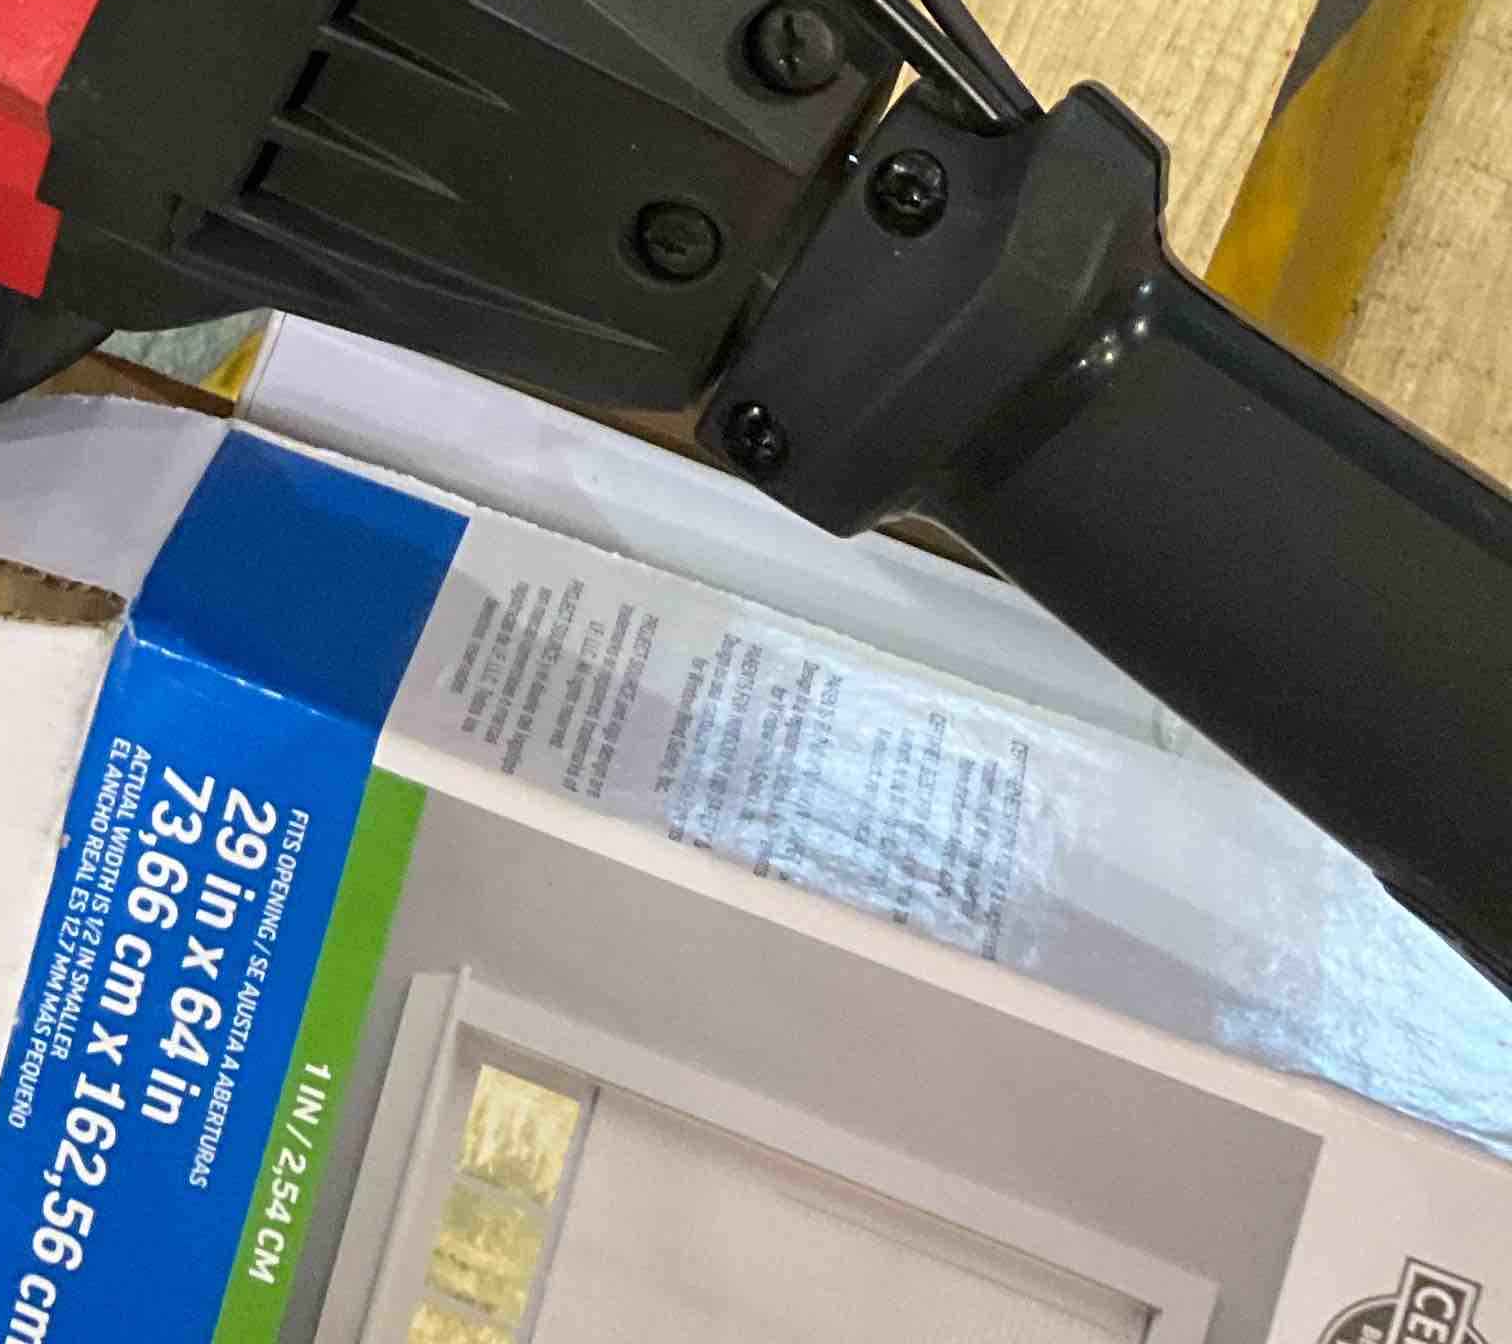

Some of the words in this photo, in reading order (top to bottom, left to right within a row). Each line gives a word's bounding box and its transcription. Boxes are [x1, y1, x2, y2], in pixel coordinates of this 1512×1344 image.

[111, 737, 131, 757] EL
[90, 753, 127, 834] ANCHO
[115, 744, 152, 819] ACTUAL
[127, 766, 216, 930] 73,66
[215, 787, 277, 870] 29
[282, 809, 310, 853] FITS
[75, 834, 105, 881] REAL
[97, 826, 131, 893] WIDTH
[68, 886, 90, 913] ES
[91, 893, 112, 914] IS
[195, 873, 256, 929] in
[257, 853, 297, 942] OPENING
[58, 915, 82, 954] 12.7
[81, 916, 105, 946] 1/2
[252, 939, 272, 957] /
[46, 953, 72, 992] MM
[75, 946, 97, 970] IN
[99, 933, 152, 1016] cm
[181, 935, 225, 980] x
[246, 954, 269, 983] SE
[33, 991, 61, 1037] MÁS
[49, 969, 90, 1060] SMALLER
[159, 986, 222, 1067] 64
[225, 981, 261, 1052] AJUSTA
[86, 1021, 129, 1066] x
[220, 1054, 240, 1070] A
[7, 1036, 48, 1129] PEQUEÑO
[304, 1063, 332, 1080] 1
[140, 1068, 201, 1125] in
[292, 1084, 326, 1125] IN
[189, 1071, 235, 1189] ABERTURAS
[285, 1122, 313, 1149] /
[32, 1072, 126, 1271] 162,56
[264, 1147, 307, 1224] 2,54
[248, 1227, 285, 1284] CM
